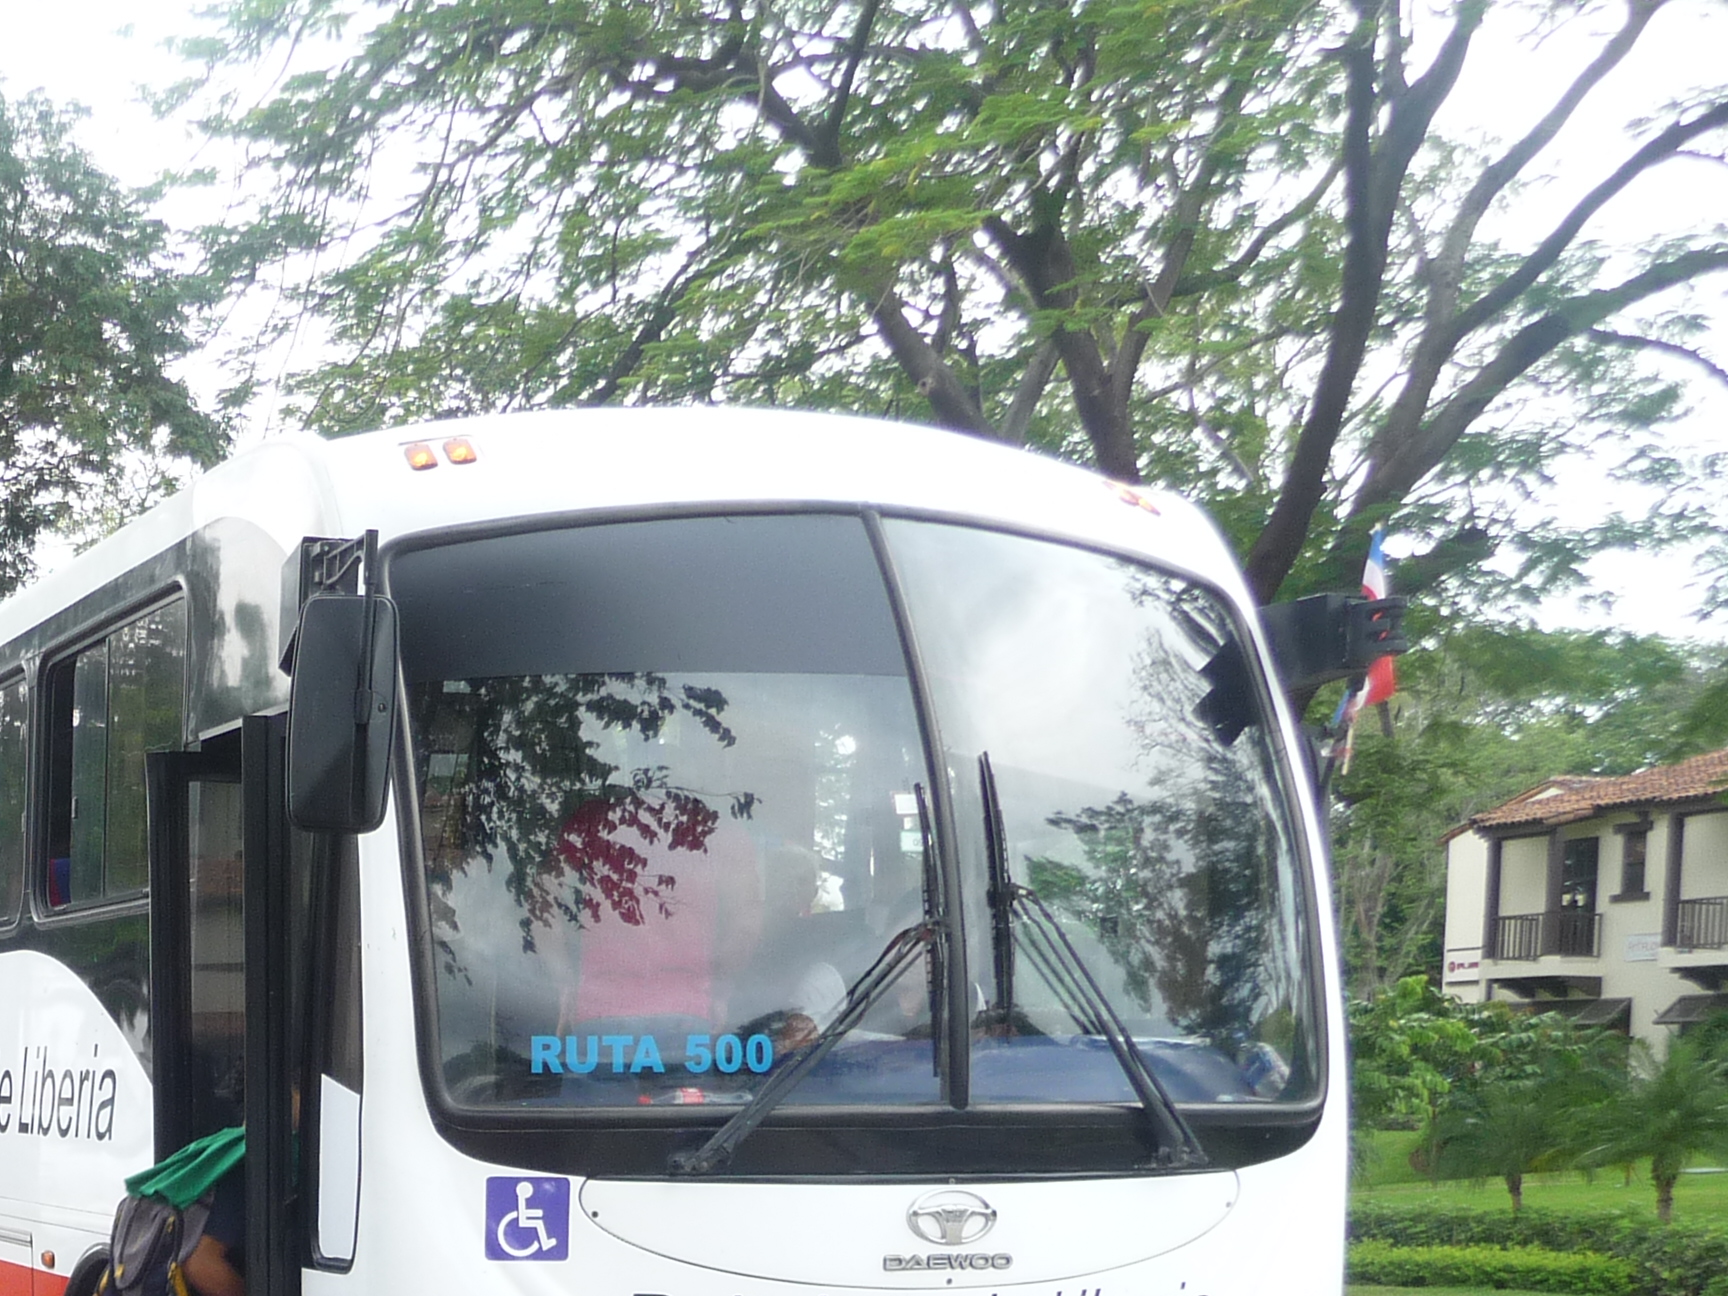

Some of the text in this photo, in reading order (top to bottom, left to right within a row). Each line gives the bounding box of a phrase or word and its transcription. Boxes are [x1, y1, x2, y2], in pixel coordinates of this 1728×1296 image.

[531, 1034, 772, 1074] RUTA 500
[18, 1043, 118, 1142] Liberia
[883, 1253, 1013, 1271] DAEWOO
